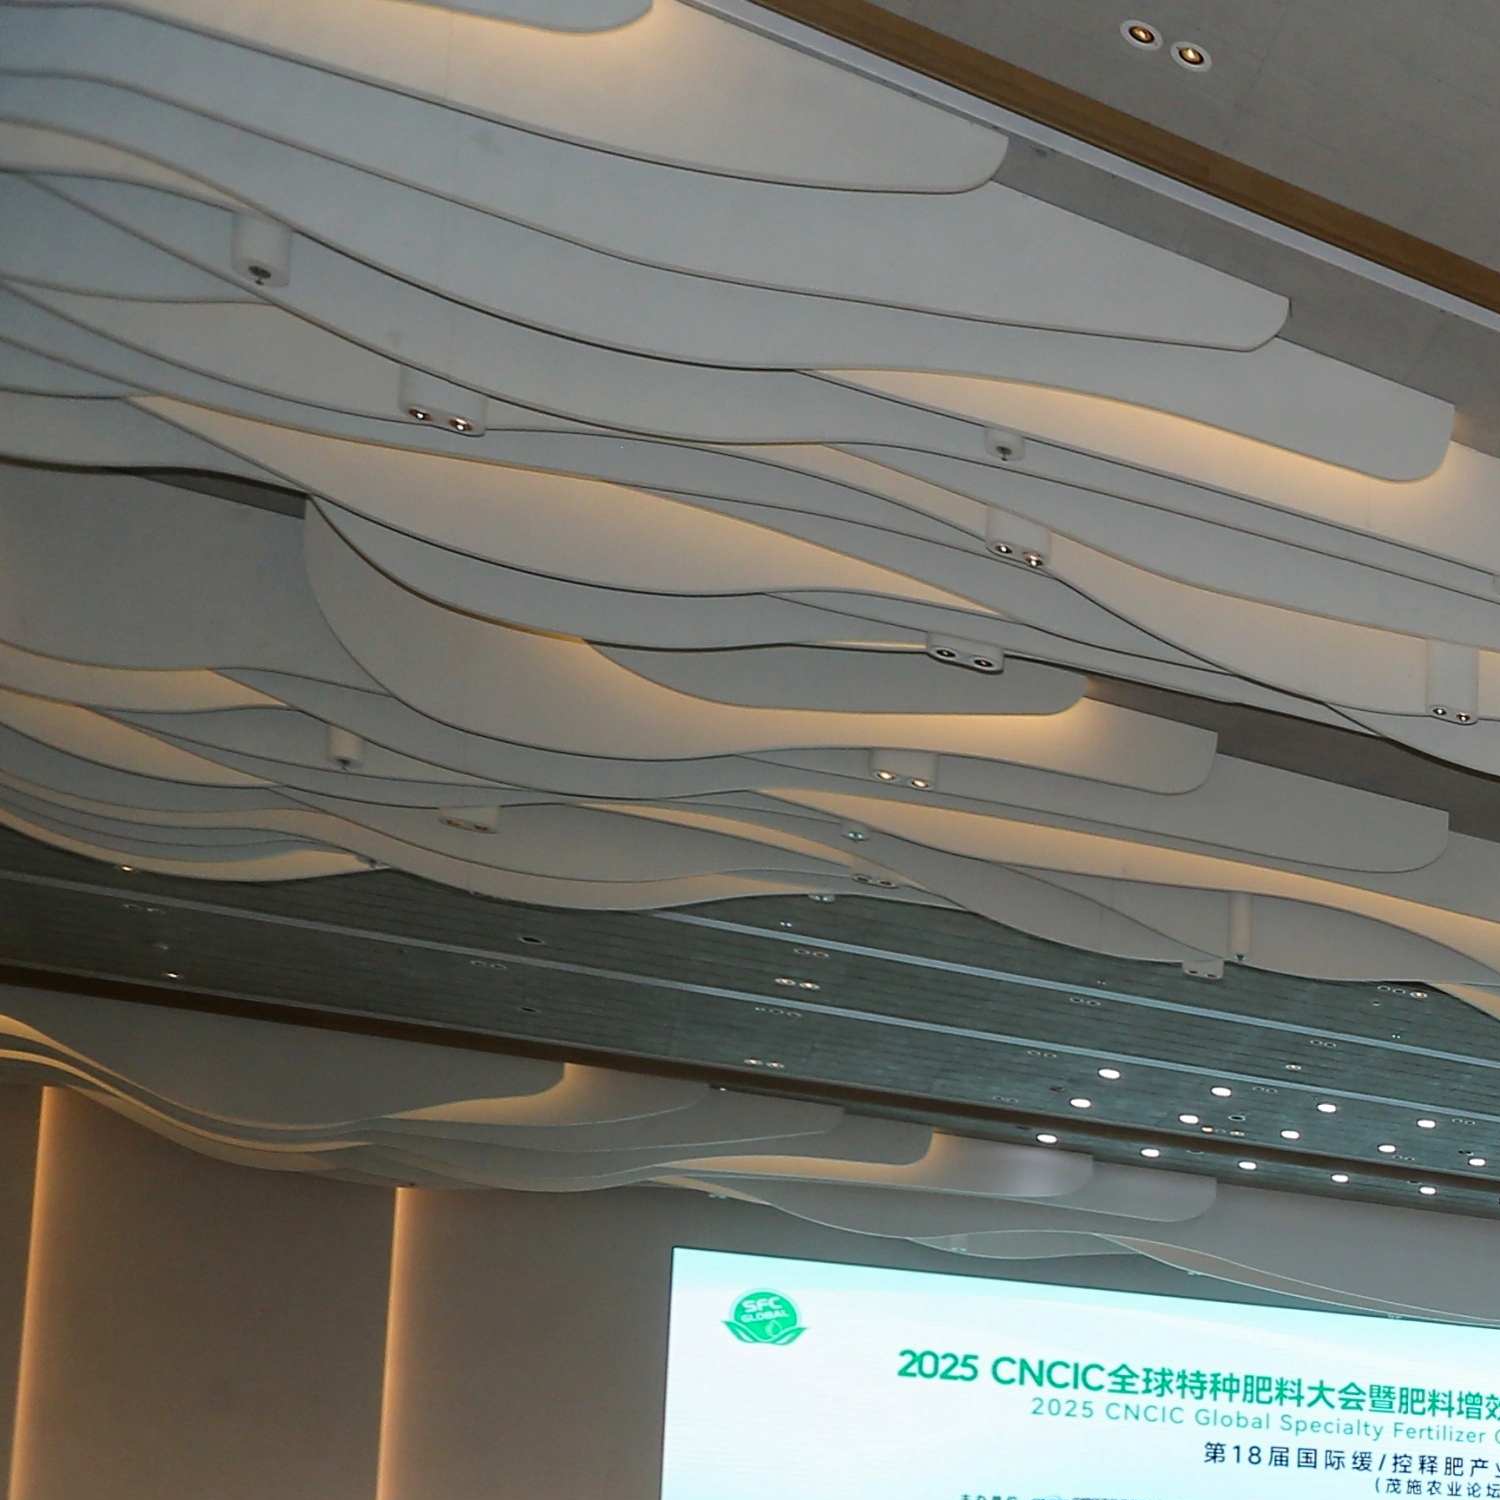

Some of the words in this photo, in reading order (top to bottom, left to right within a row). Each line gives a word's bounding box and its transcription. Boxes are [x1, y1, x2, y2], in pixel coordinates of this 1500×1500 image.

[742, 1297, 783, 1312] SFC
[897, 1349, 979, 1382] 2025
[1031, 1397, 1095, 1419] 2025
[1105, 1402, 1184, 1424] CNCIC
[1195, 1408, 1270, 1430] Global
[1280, 1414, 1383, 1442] Specialty
[1394, 1421, 1486, 1444] Fertilizer
